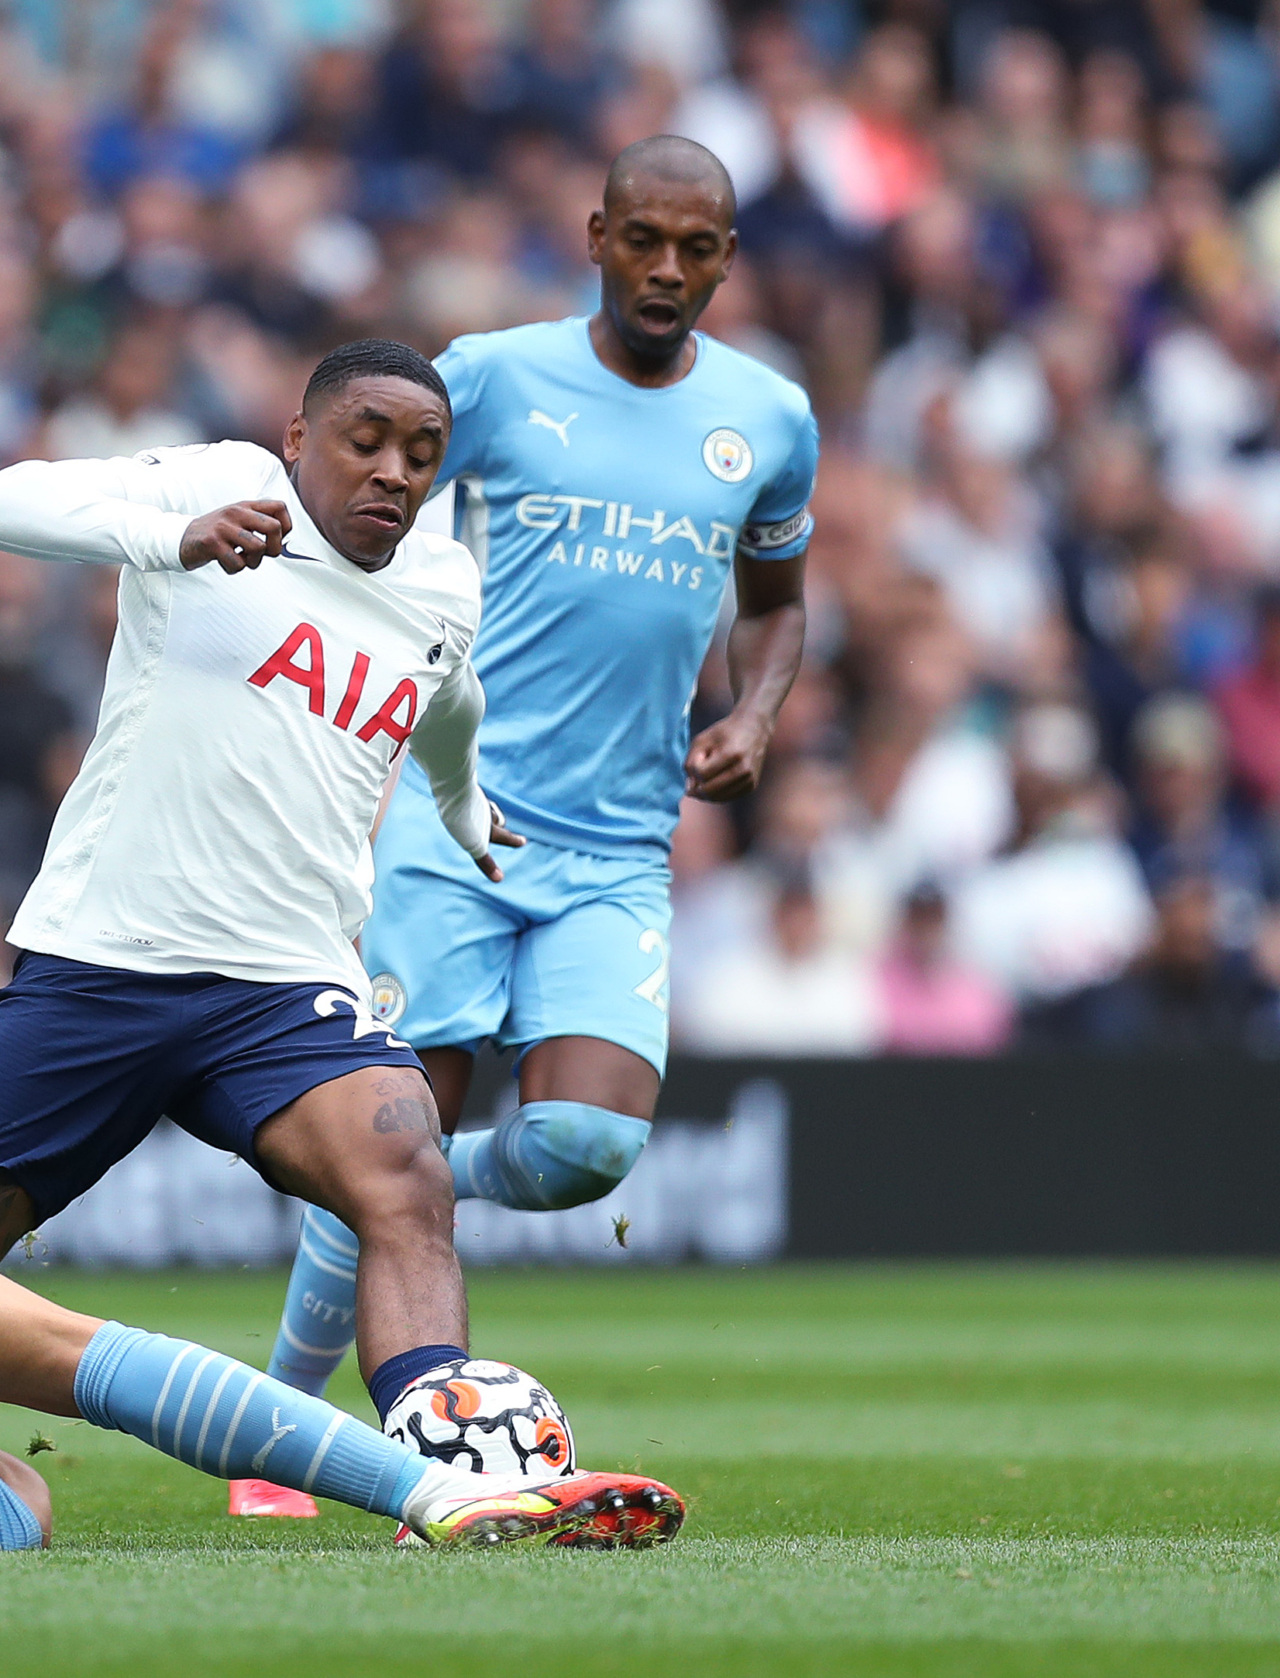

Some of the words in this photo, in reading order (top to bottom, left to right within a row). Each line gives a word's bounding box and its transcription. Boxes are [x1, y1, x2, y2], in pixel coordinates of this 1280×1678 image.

[516, 494, 738, 558] ETIHAD
[547, 541, 704, 590] AIRWAYS
[247, 622, 418, 764] AIA
[302, 1290, 356, 1326] CITY
